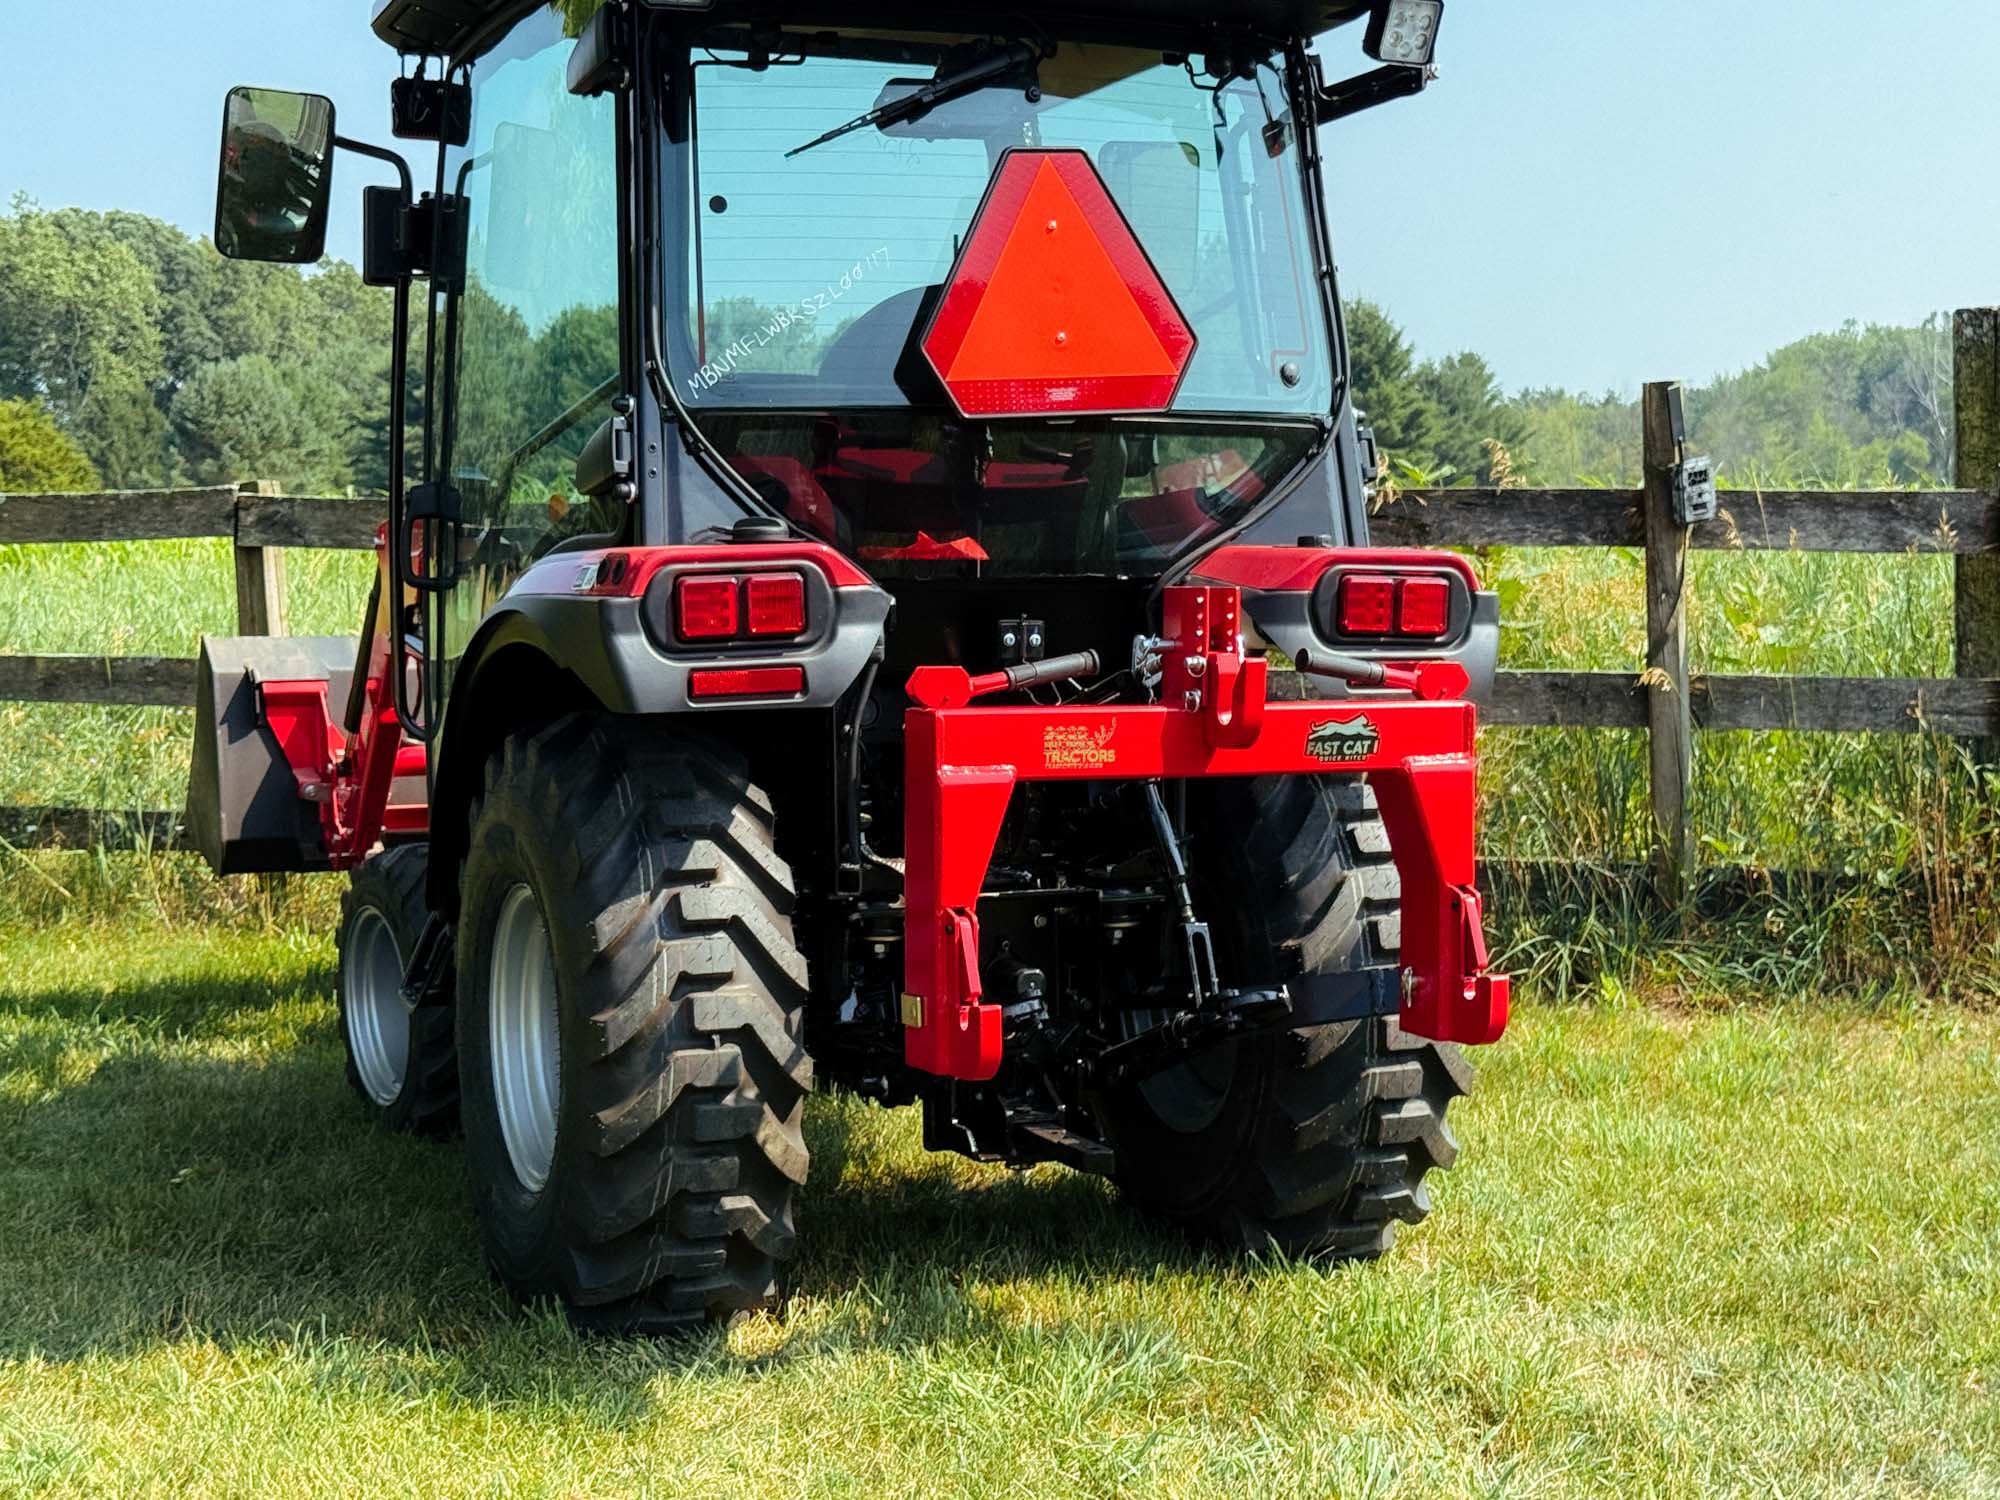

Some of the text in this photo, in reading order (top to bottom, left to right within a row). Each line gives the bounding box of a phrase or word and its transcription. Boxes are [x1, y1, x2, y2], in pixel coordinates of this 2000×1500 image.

[1306, 741, 1340, 755] FAST
[1343, 740, 1371, 755] CAT
[1043, 749, 1115, 762] TRACTORS
